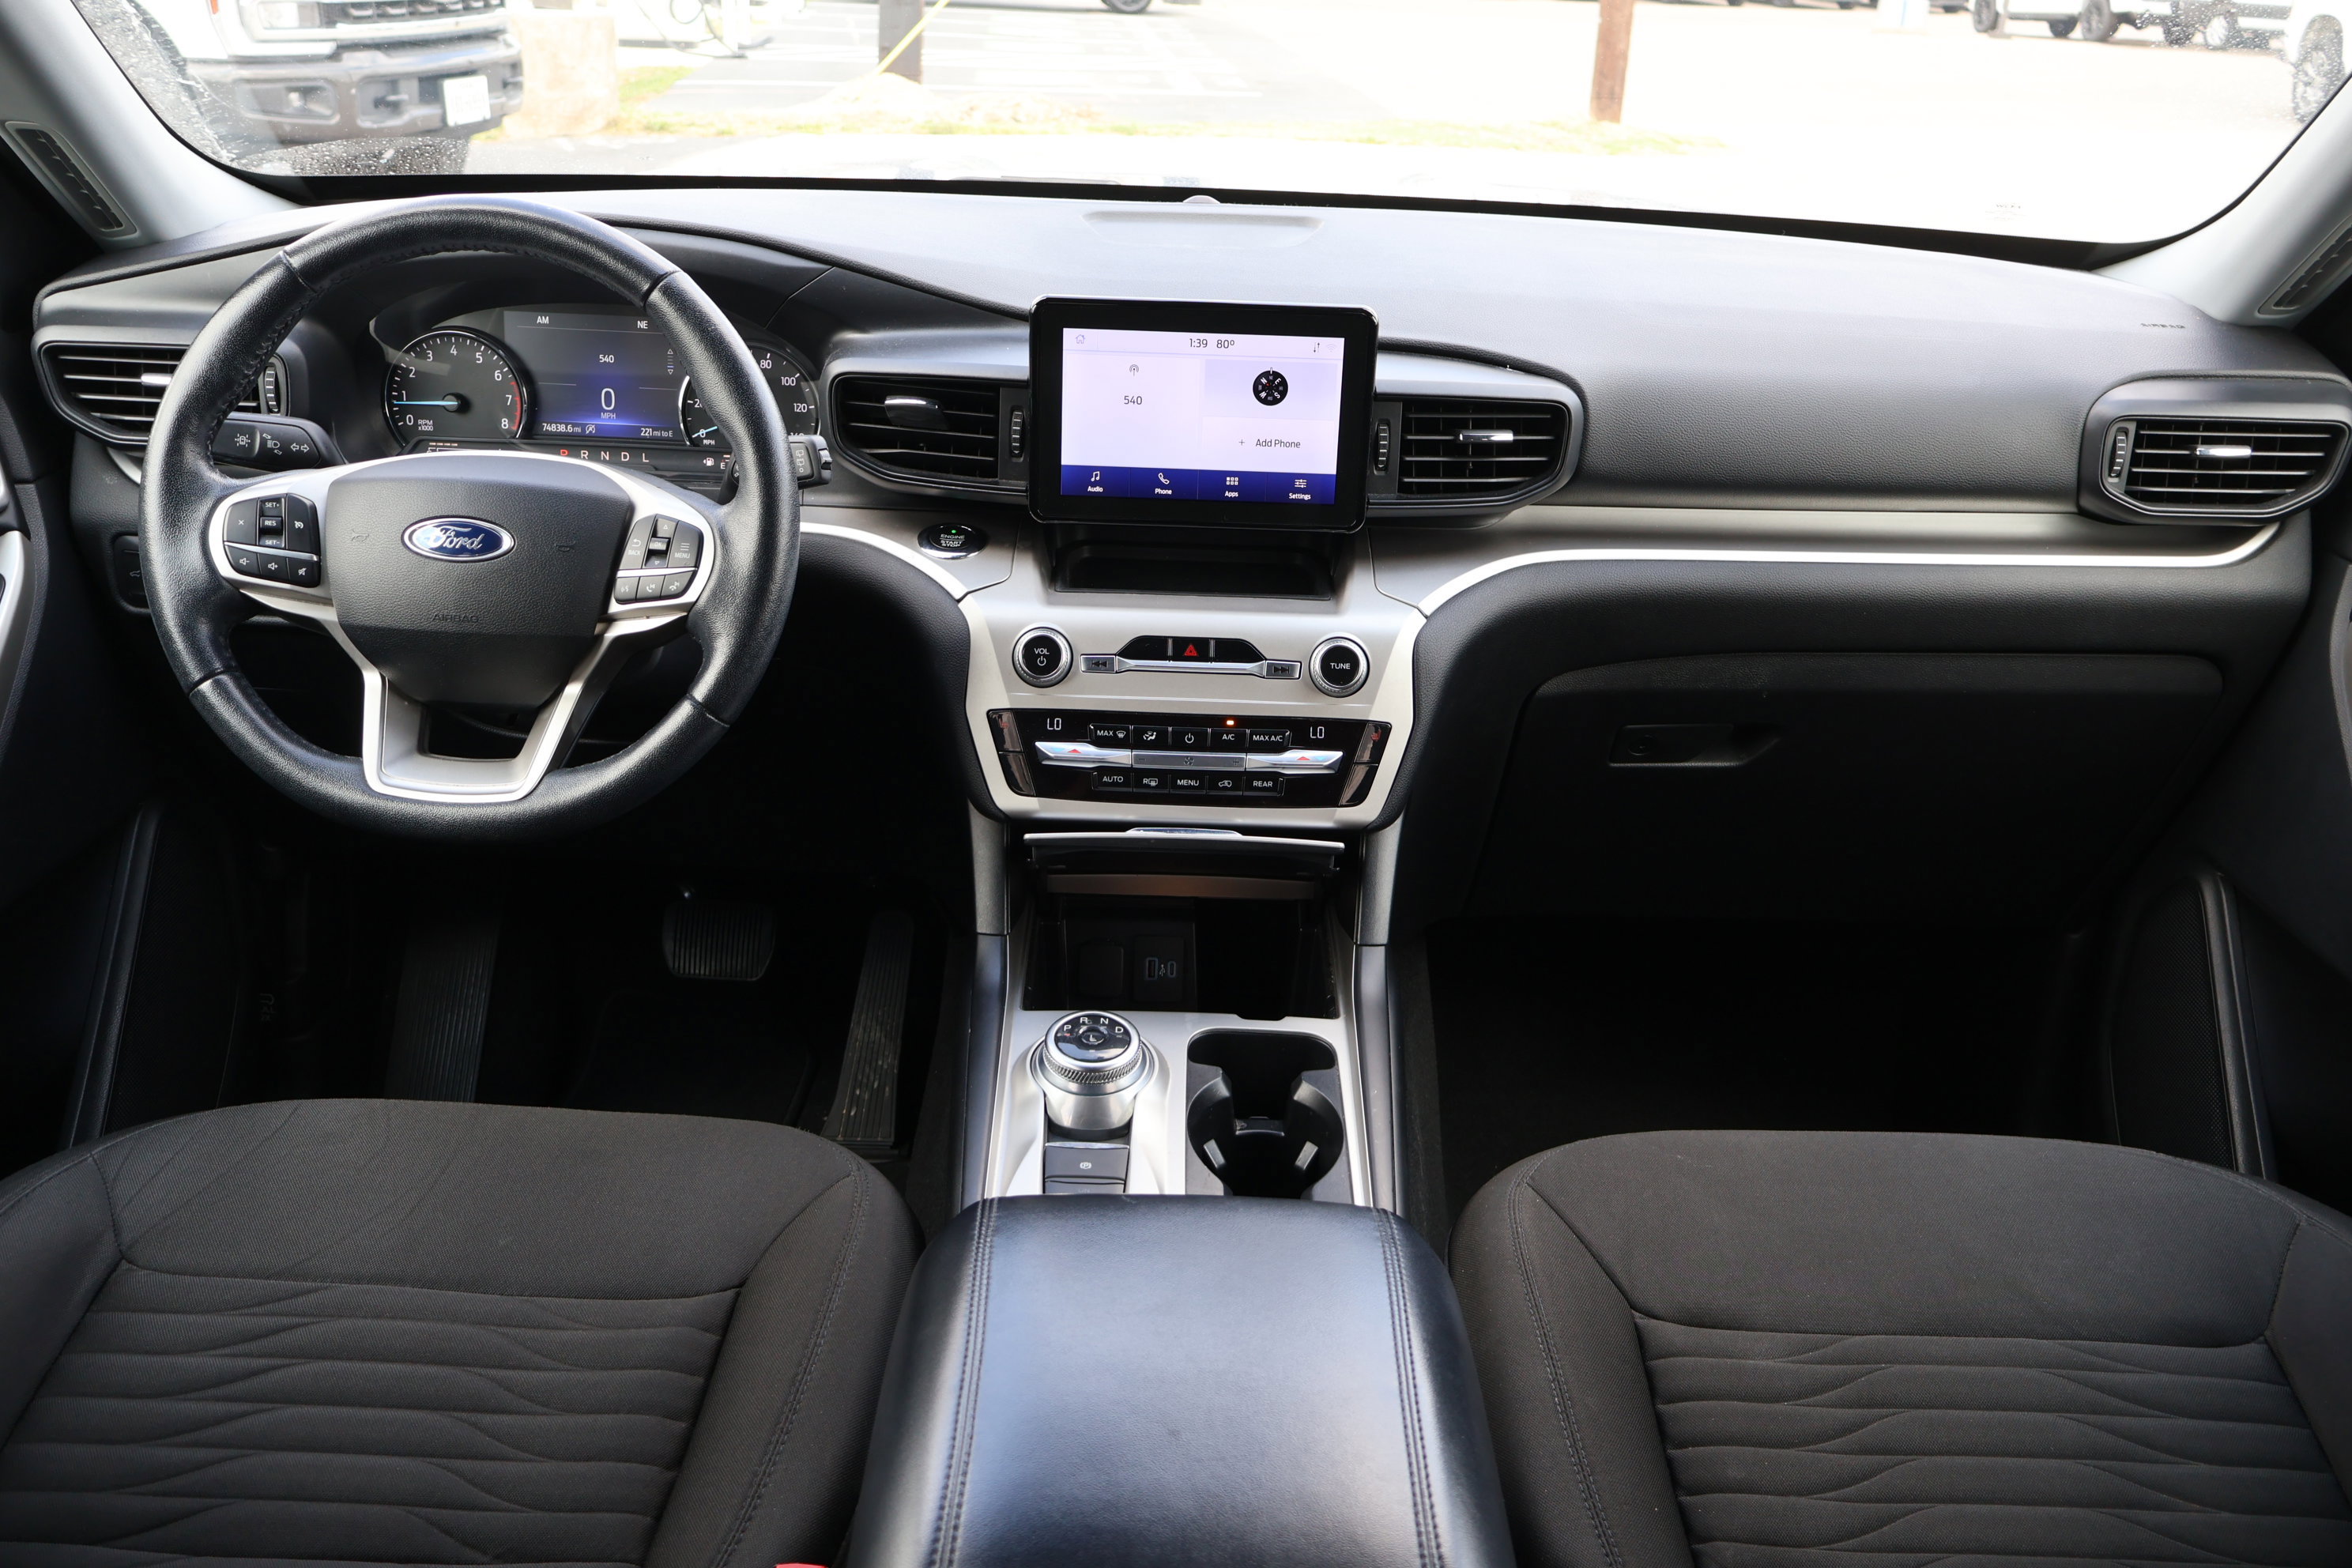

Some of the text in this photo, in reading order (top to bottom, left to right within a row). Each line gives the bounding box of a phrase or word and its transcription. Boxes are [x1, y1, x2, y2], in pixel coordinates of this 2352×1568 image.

[537, 315, 549, 324] AM
[637, 320, 648, 329] NE
[1189, 338, 1208, 348] 1:39
[427, 350, 433, 361] 3
[450, 345, 458, 356] 4
[476, 352, 483, 364] 5
[598, 354, 615, 363] 540
[760, 360, 772, 369] 80
[409, 366, 416, 378] 2
[494, 370, 502, 381] 6
[781, 376, 796, 386] 100
[401, 390, 406, 401] 1
[506, 394, 512, 405] 7
[601, 387, 616, 411] 0
[1123, 395, 1143, 405] 540
[793, 403, 808, 413] 120
[406, 414, 414, 425] 0
[501, 418, 508, 429] 8
[542, 423, 573, 432] 74838.6
[640, 428, 653, 436] 221
[1255, 438, 1301, 448] Add Phone
[581, 450, 589, 459] R
[601, 450, 609, 460] N
[620, 451, 630, 462] D
[642, 453, 649, 462] L
[720, 462, 726, 470] E
[431, 526, 484, 550] Ford
[1046, 718, 1061, 730] LO
[1310, 726, 1325, 738] LO
